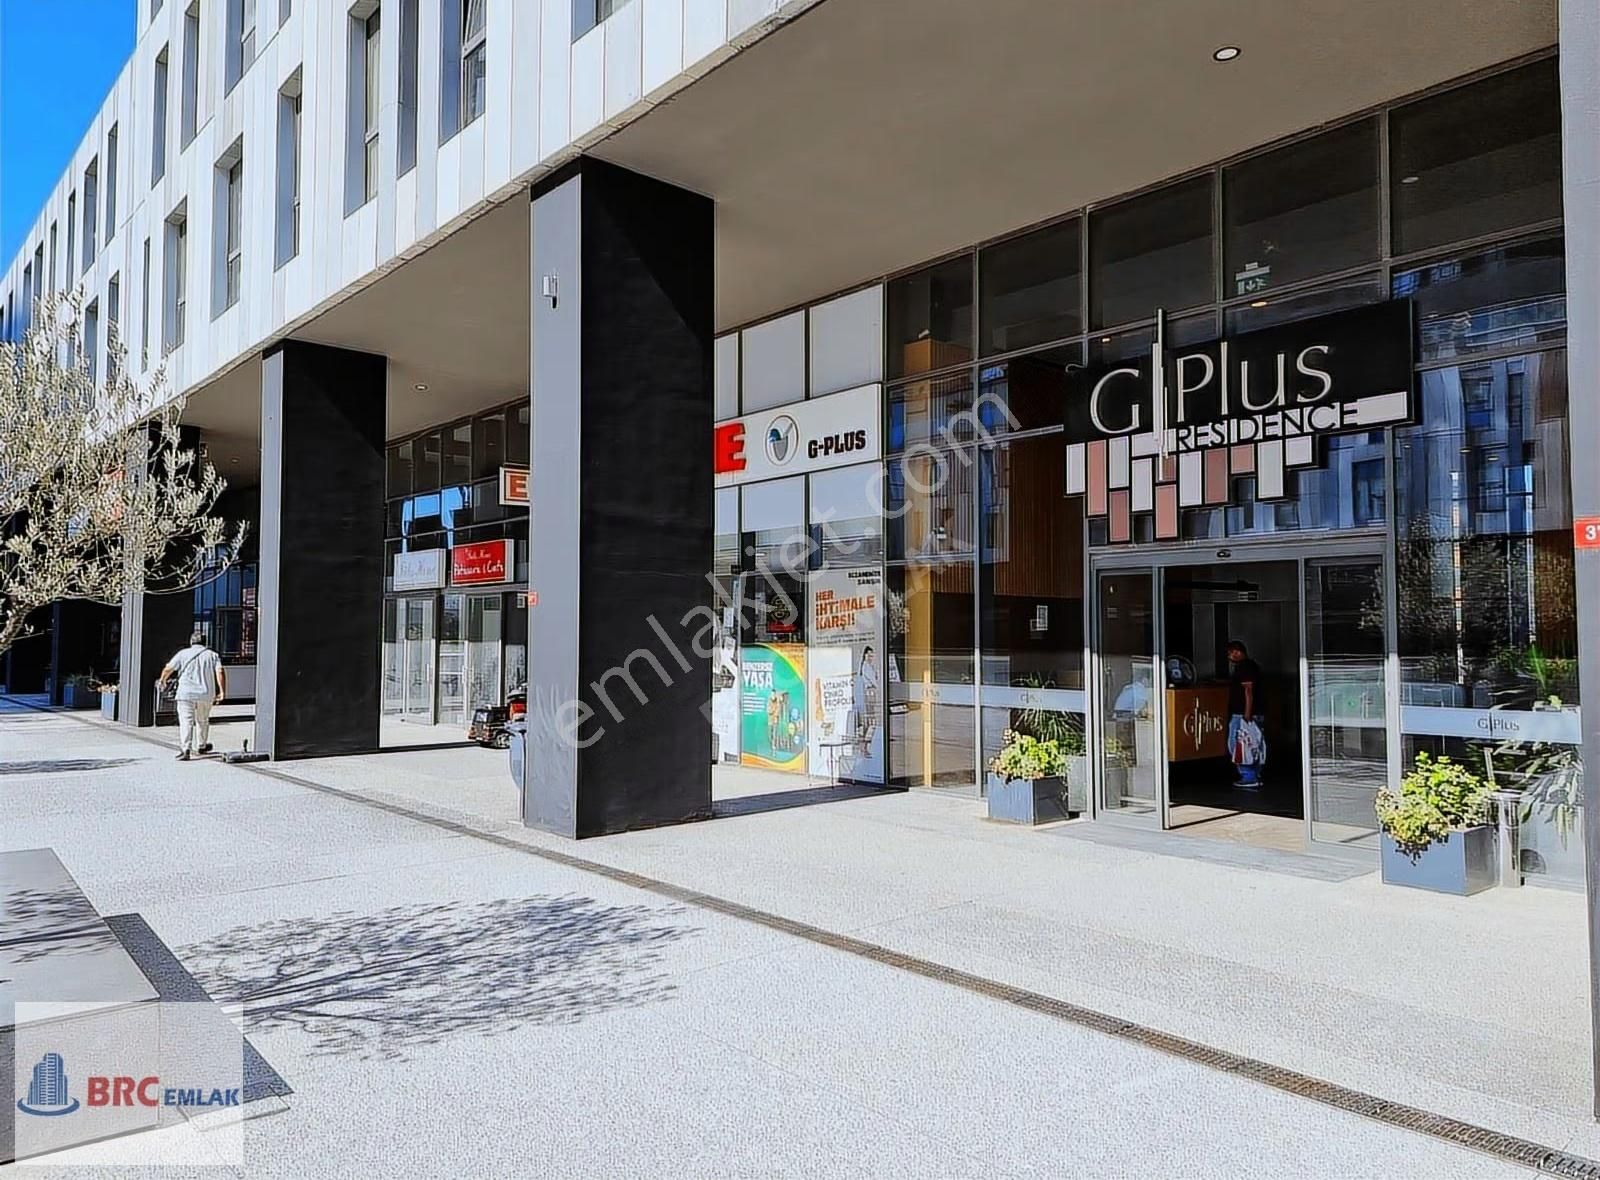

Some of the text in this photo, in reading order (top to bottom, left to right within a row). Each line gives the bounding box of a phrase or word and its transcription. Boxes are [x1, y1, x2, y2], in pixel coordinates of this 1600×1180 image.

[1176, 402, 1359, 451] RESIDENCE
[807, 429, 867, 459] G-PLUS
[816, 590, 834, 602] HER
